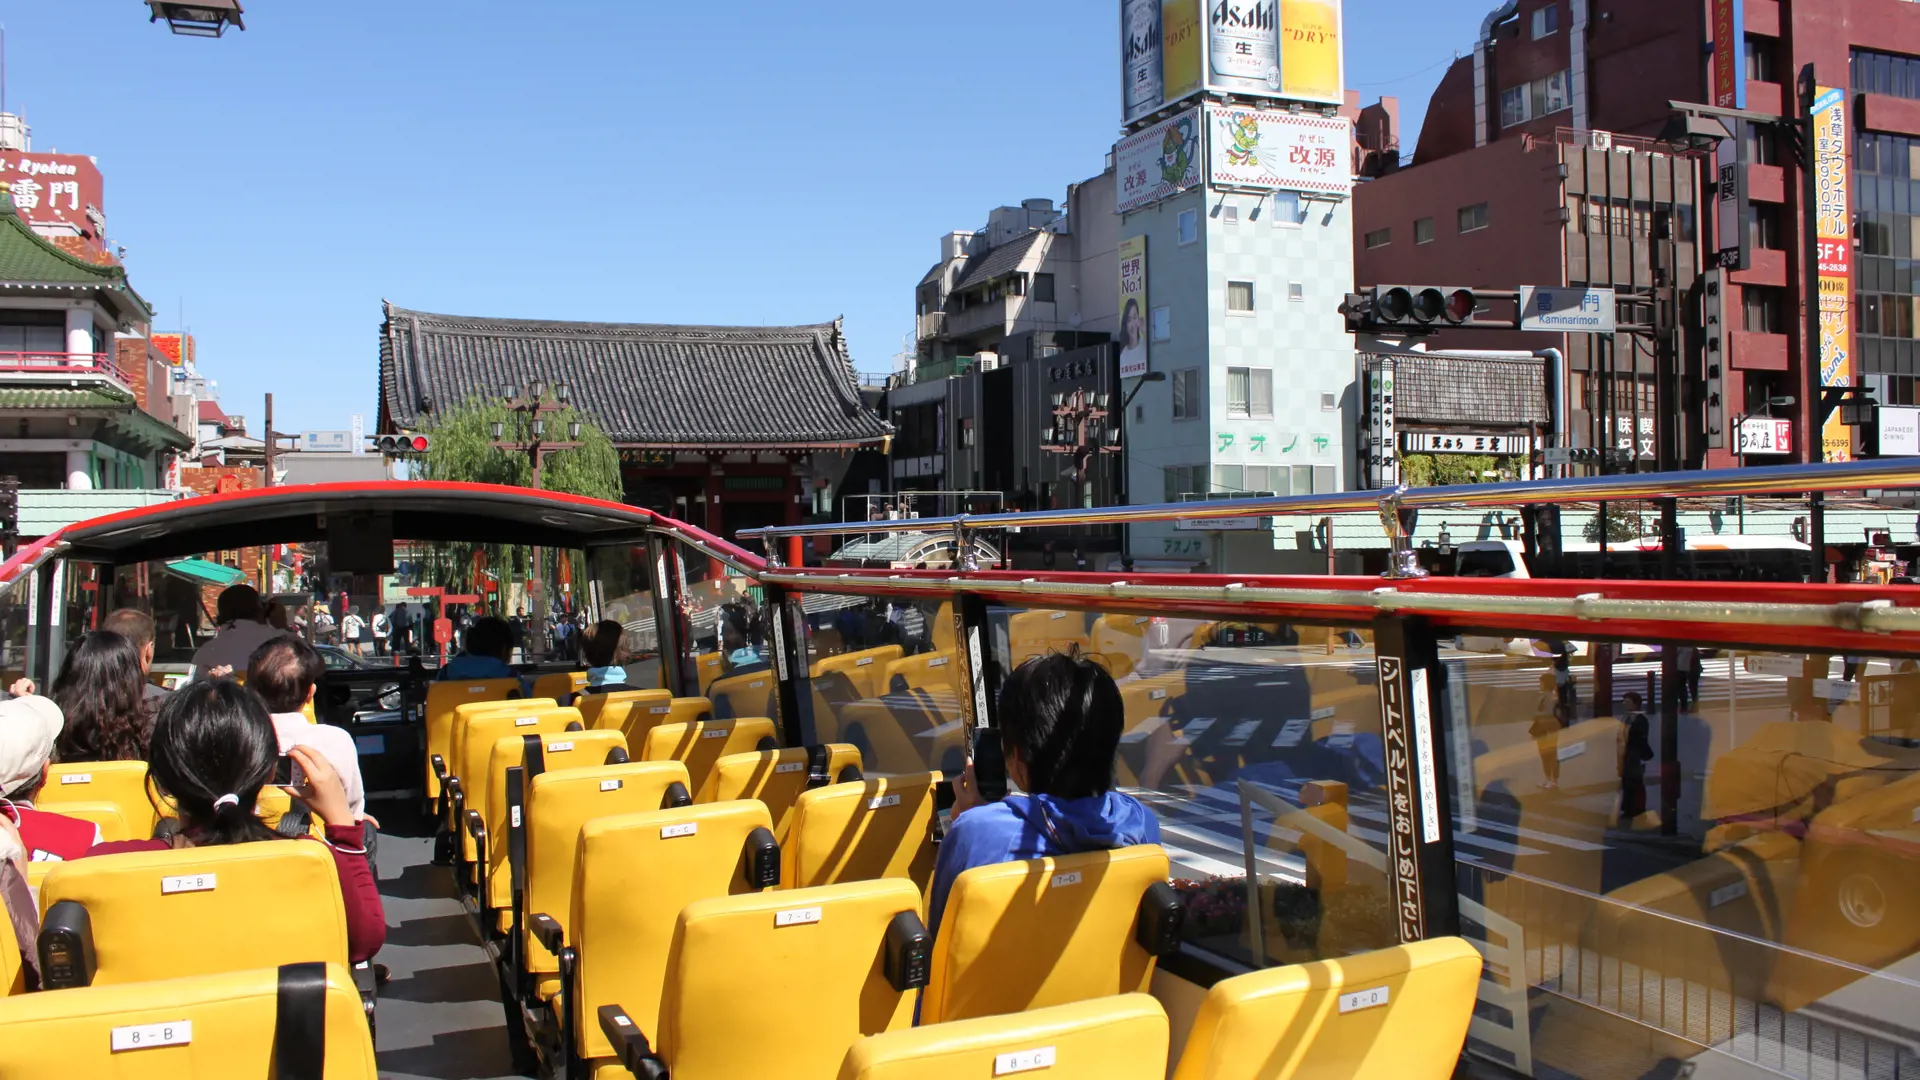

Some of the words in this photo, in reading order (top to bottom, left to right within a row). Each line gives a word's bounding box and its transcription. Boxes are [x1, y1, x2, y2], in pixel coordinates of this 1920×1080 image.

[1212, 0, 1274, 32] Asahi
[1235, 41, 1252, 55] 生
[1719, 0, 1730, 90] タウンホテル
[1137, 67, 1147, 83] 生
[1719, 93, 1732, 107] 5F
[1289, 145, 1335, 167] 改源
[18, 158, 77, 176] Ryokan
[1830, 107, 1846, 236] 浅草タウンホテル
[9, 178, 79, 210] 雷門
[1121, 259, 1140, 277] 世界
[1121, 276, 1142, 294] No.1
[1539, 314, 1599, 325] Kaminarimon
[1777, 423, 1789, 436] 1F
[1218, 432, 1329, 454] アオノヤ
[1414, 670, 1437, 841] シートベルトをおしめ下さい
[1383, 661, 1420, 939] シートベルトをおしめ下さい
